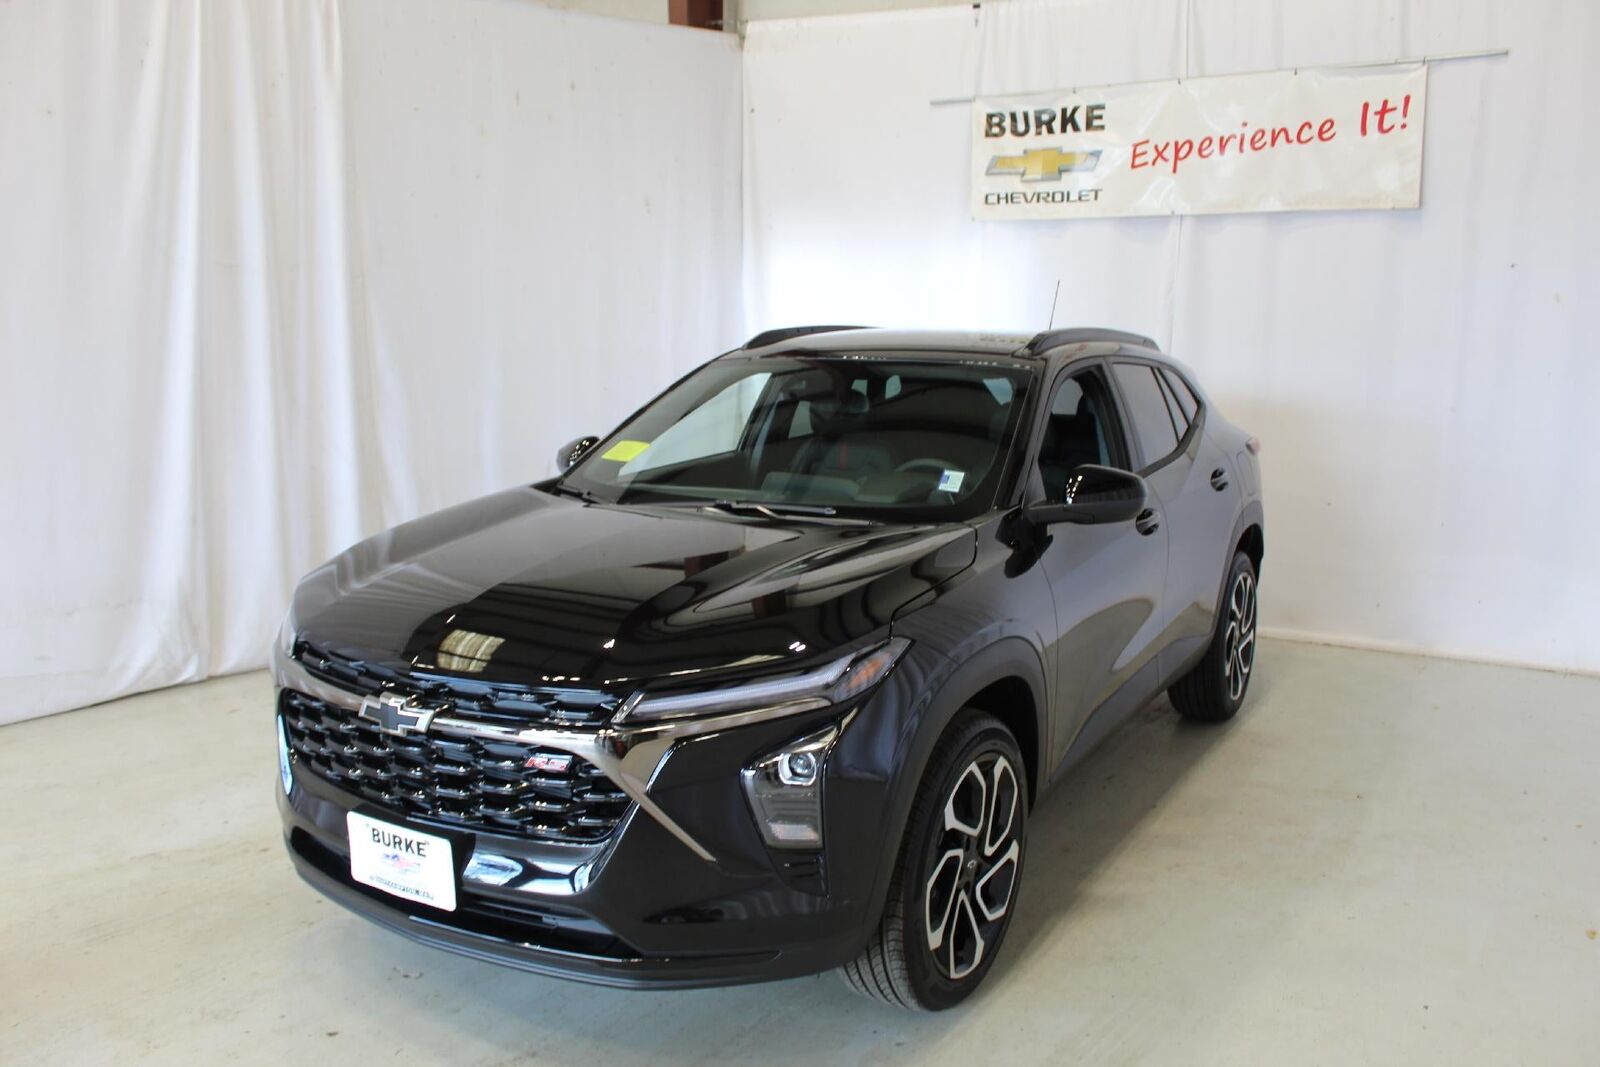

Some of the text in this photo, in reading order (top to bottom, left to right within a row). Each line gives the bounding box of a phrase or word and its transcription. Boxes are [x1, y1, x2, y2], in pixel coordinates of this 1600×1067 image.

[985, 104, 1106, 137] BURKE
[1131, 95, 1411, 173] Experience It!
[984, 189, 1102, 206] CHEVROLET
[372, 827, 426, 857] BURKE
